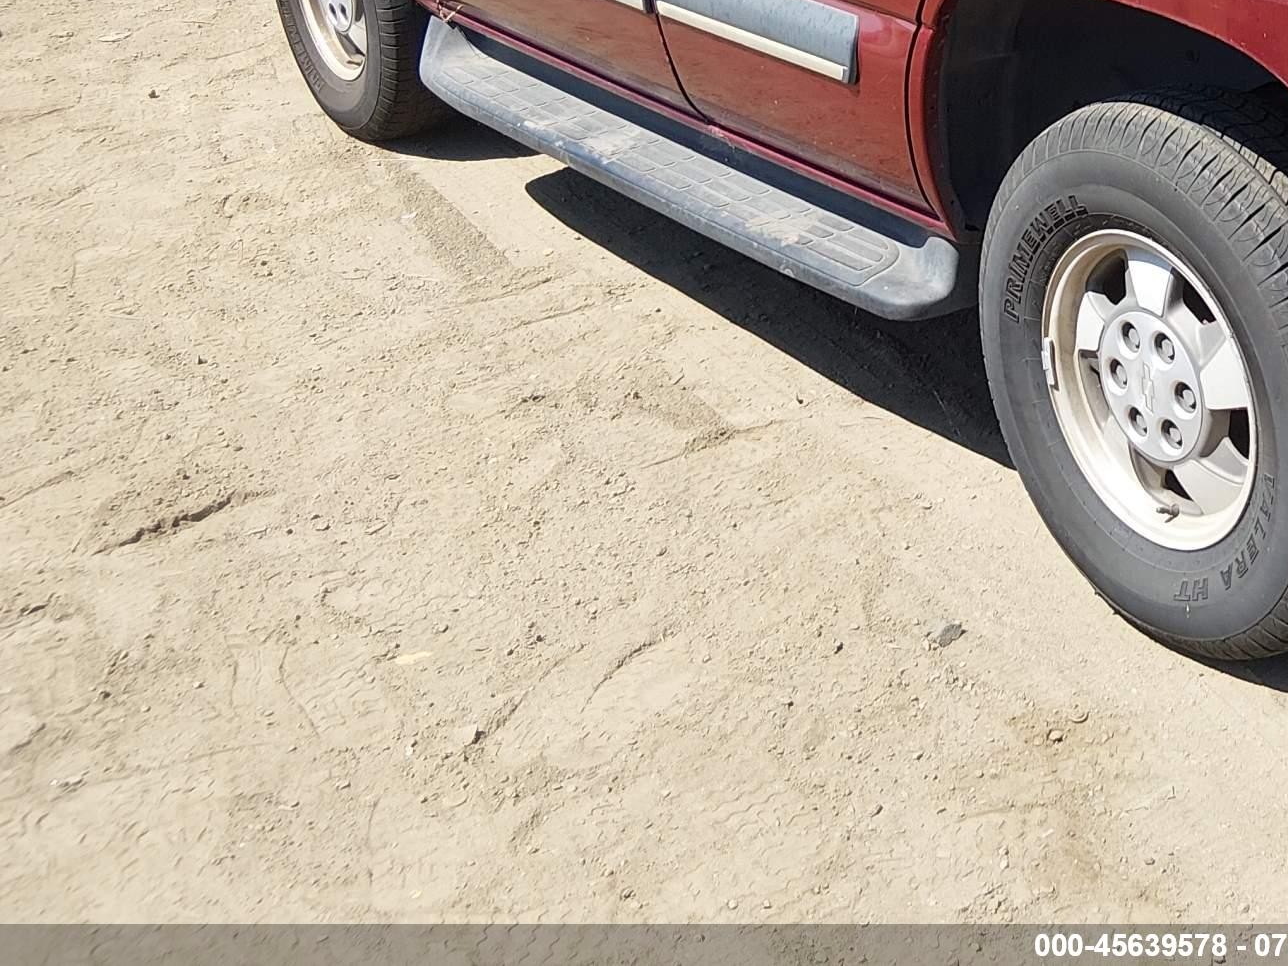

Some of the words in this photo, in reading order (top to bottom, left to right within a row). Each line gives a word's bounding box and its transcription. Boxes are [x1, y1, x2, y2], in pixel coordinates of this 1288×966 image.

[1003, 194, 1089, 324] PRIMEWELL
[1173, 577, 1209, 603] HT
[1219, 473, 1275, 592] VALERA
